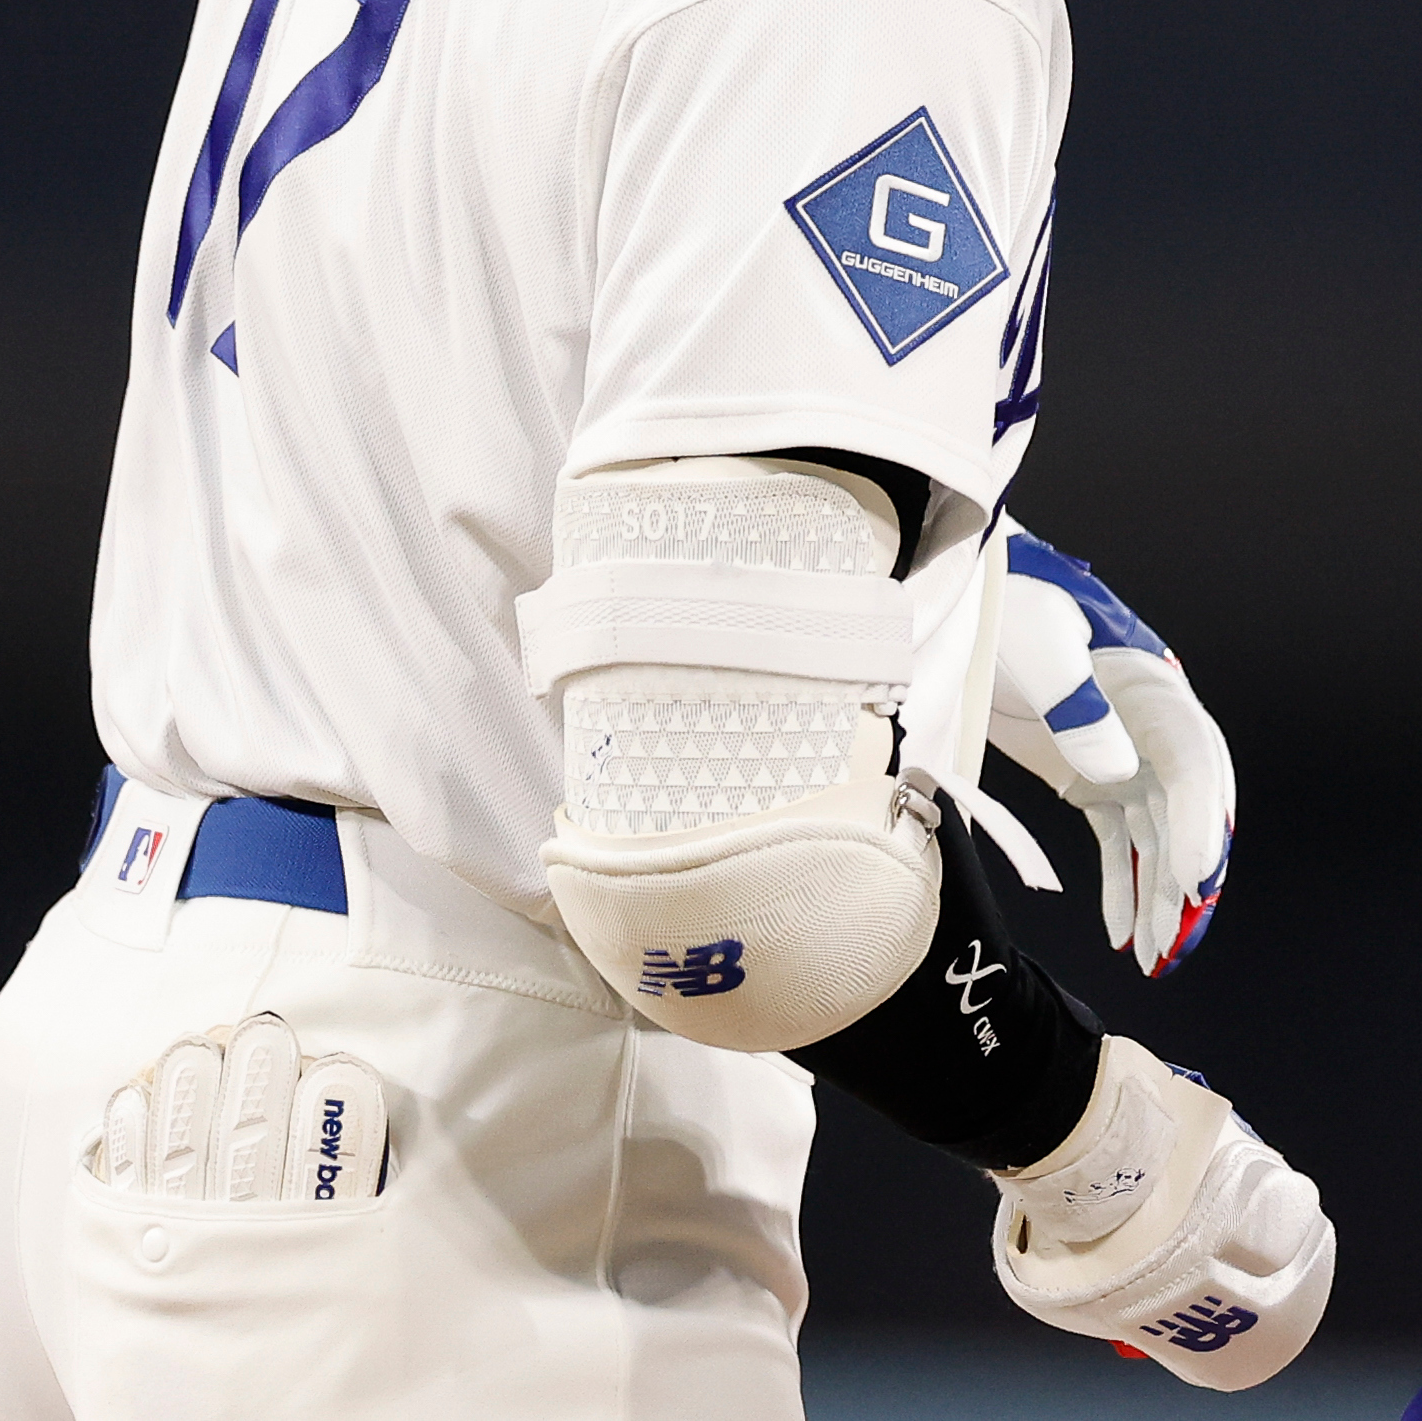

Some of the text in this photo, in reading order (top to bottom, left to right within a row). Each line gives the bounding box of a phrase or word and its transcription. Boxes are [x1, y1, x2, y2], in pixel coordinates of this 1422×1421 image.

[868, 173, 951, 263] G
[840, 250, 961, 299] GUGGENHEIM
[314, 1098, 345, 1200] new ba
